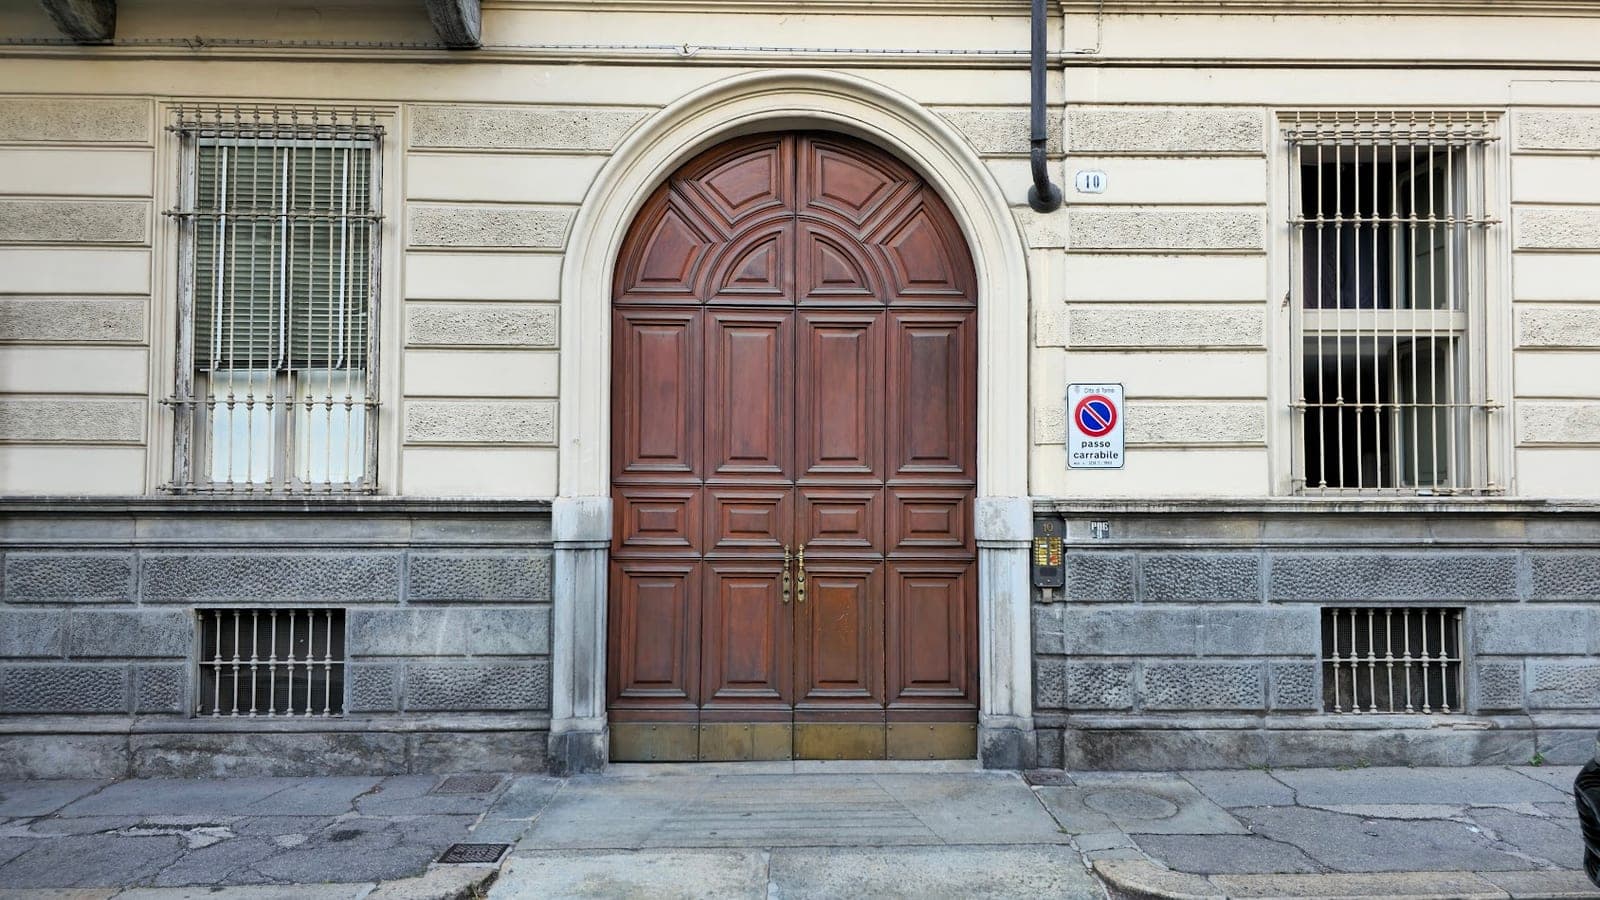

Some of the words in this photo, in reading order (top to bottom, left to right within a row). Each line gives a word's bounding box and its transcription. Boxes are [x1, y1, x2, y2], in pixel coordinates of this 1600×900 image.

[1086, 174, 1100, 189] 10
[1073, 450, 1119, 459] carrabile
[1043, 522, 1054, 532] 10
